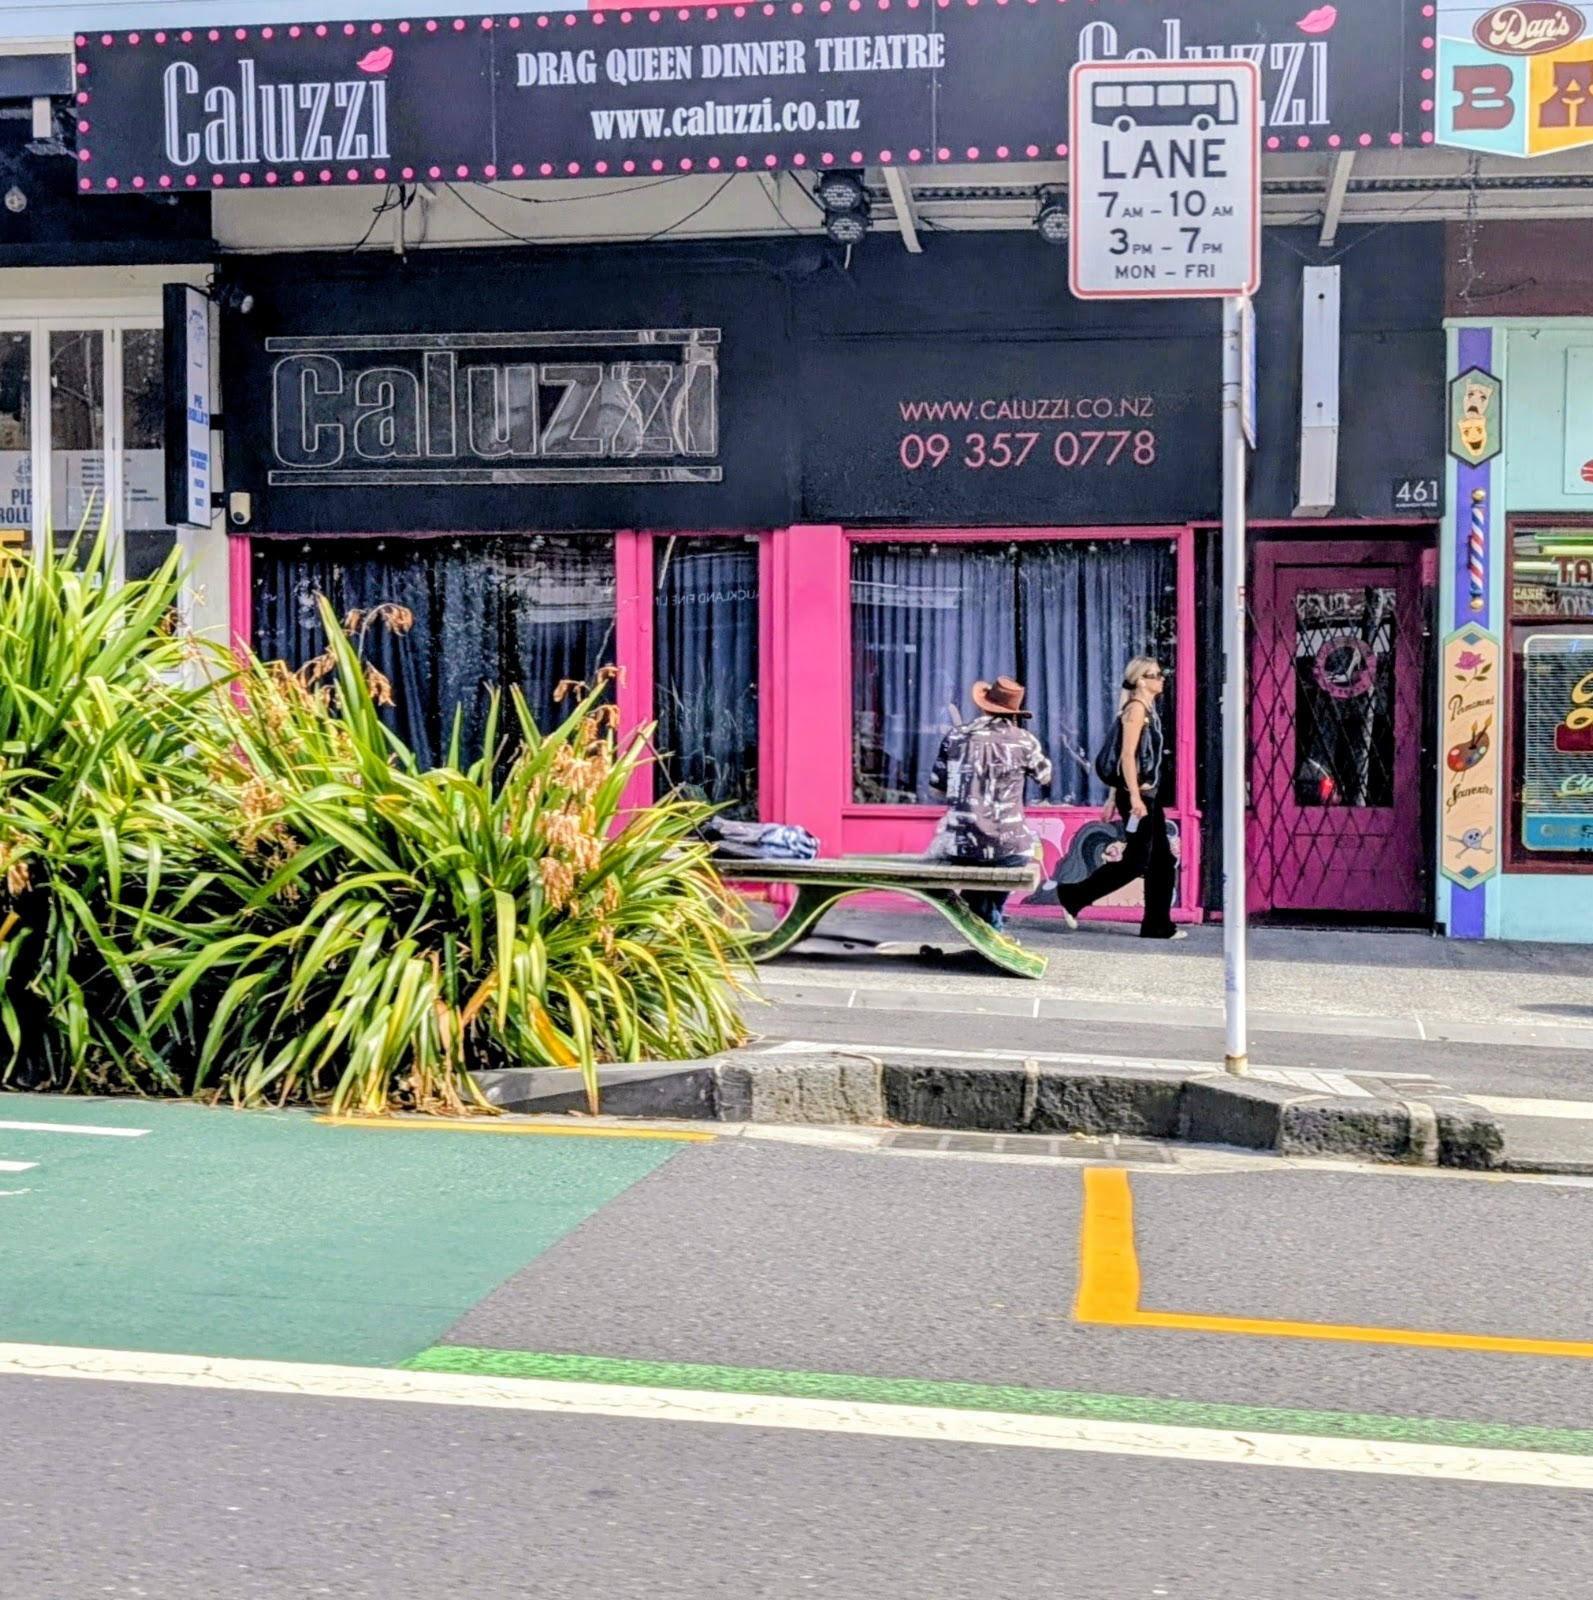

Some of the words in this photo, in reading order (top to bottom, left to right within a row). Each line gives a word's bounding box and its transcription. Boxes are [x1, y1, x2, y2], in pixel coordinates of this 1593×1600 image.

[1489, 7, 1570, 47] Dan's
[516, 49, 598, 87] DRAG
[606, 45, 693, 86] QUEEN
[701, 39, 806, 79] DINNER
[815, 32, 946, 73] THEATRE
[163, 58, 391, 167] Caluzzi
[590, 97, 861, 141] www.caluzzi.co.nz
[1102, 138, 1228, 180] LANE
[1114, 265, 1156, 279] MON
[1184, 263, 1216, 278] FRI
[272, 345, 719, 467] Caluzzi
[899, 397, 1155, 422] WWW.CALUZZI.CO.NZ
[899, 433, 951, 469] 09
[964, 431, 1041, 468] 357
[1054, 429, 1156, 467] 0778
[1395, 480, 1438, 502] 461
